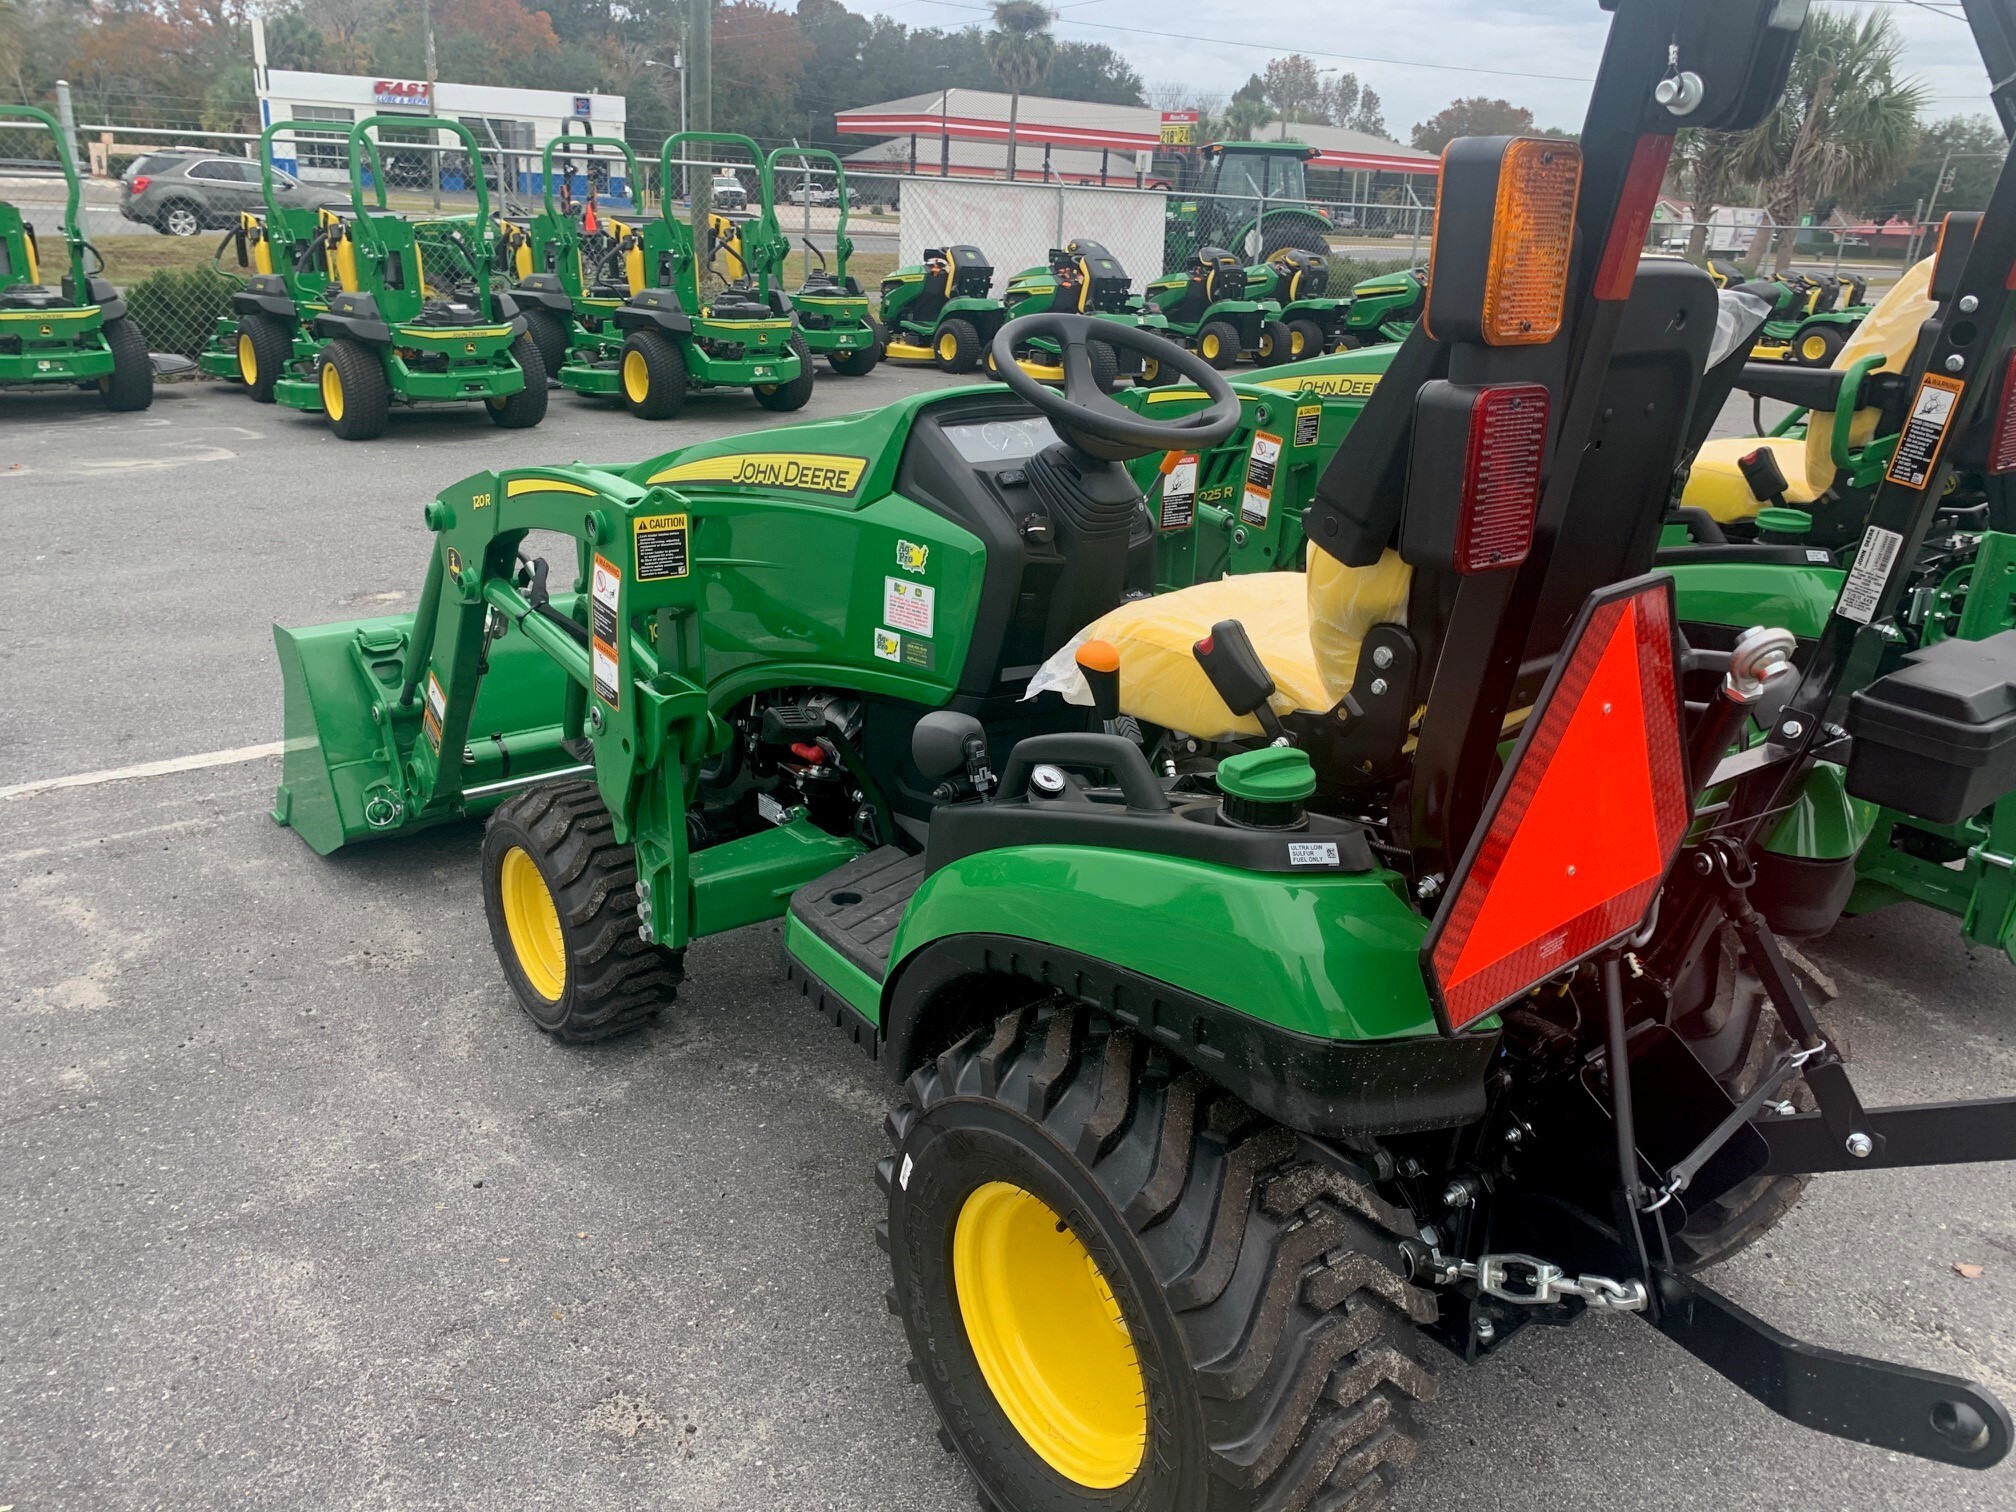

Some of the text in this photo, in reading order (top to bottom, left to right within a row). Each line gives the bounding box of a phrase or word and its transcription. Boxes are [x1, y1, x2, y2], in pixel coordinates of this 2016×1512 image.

[374, 81, 432, 97] FAST
[377, 96, 397, 104] LUBE
[1298, 379, 1378, 394] JOHN DEE
[1931, 377, 1960, 391] WARNING
[1304, 407, 1320, 415] CAUTION
[732, 459, 850, 489] JOHN DEERE
[1224, 486, 1234, 498] R
[485, 493, 491, 506] R
[649, 516, 685, 529] CAUTION
[1857, 528, 1875, 566] JOHN DEERE
[899, 552, 913, 563] Pro
[600, 557, 620, 578] WARNING
[877, 641, 888, 651] Pro
[597, 643, 617, 663] WARNING
